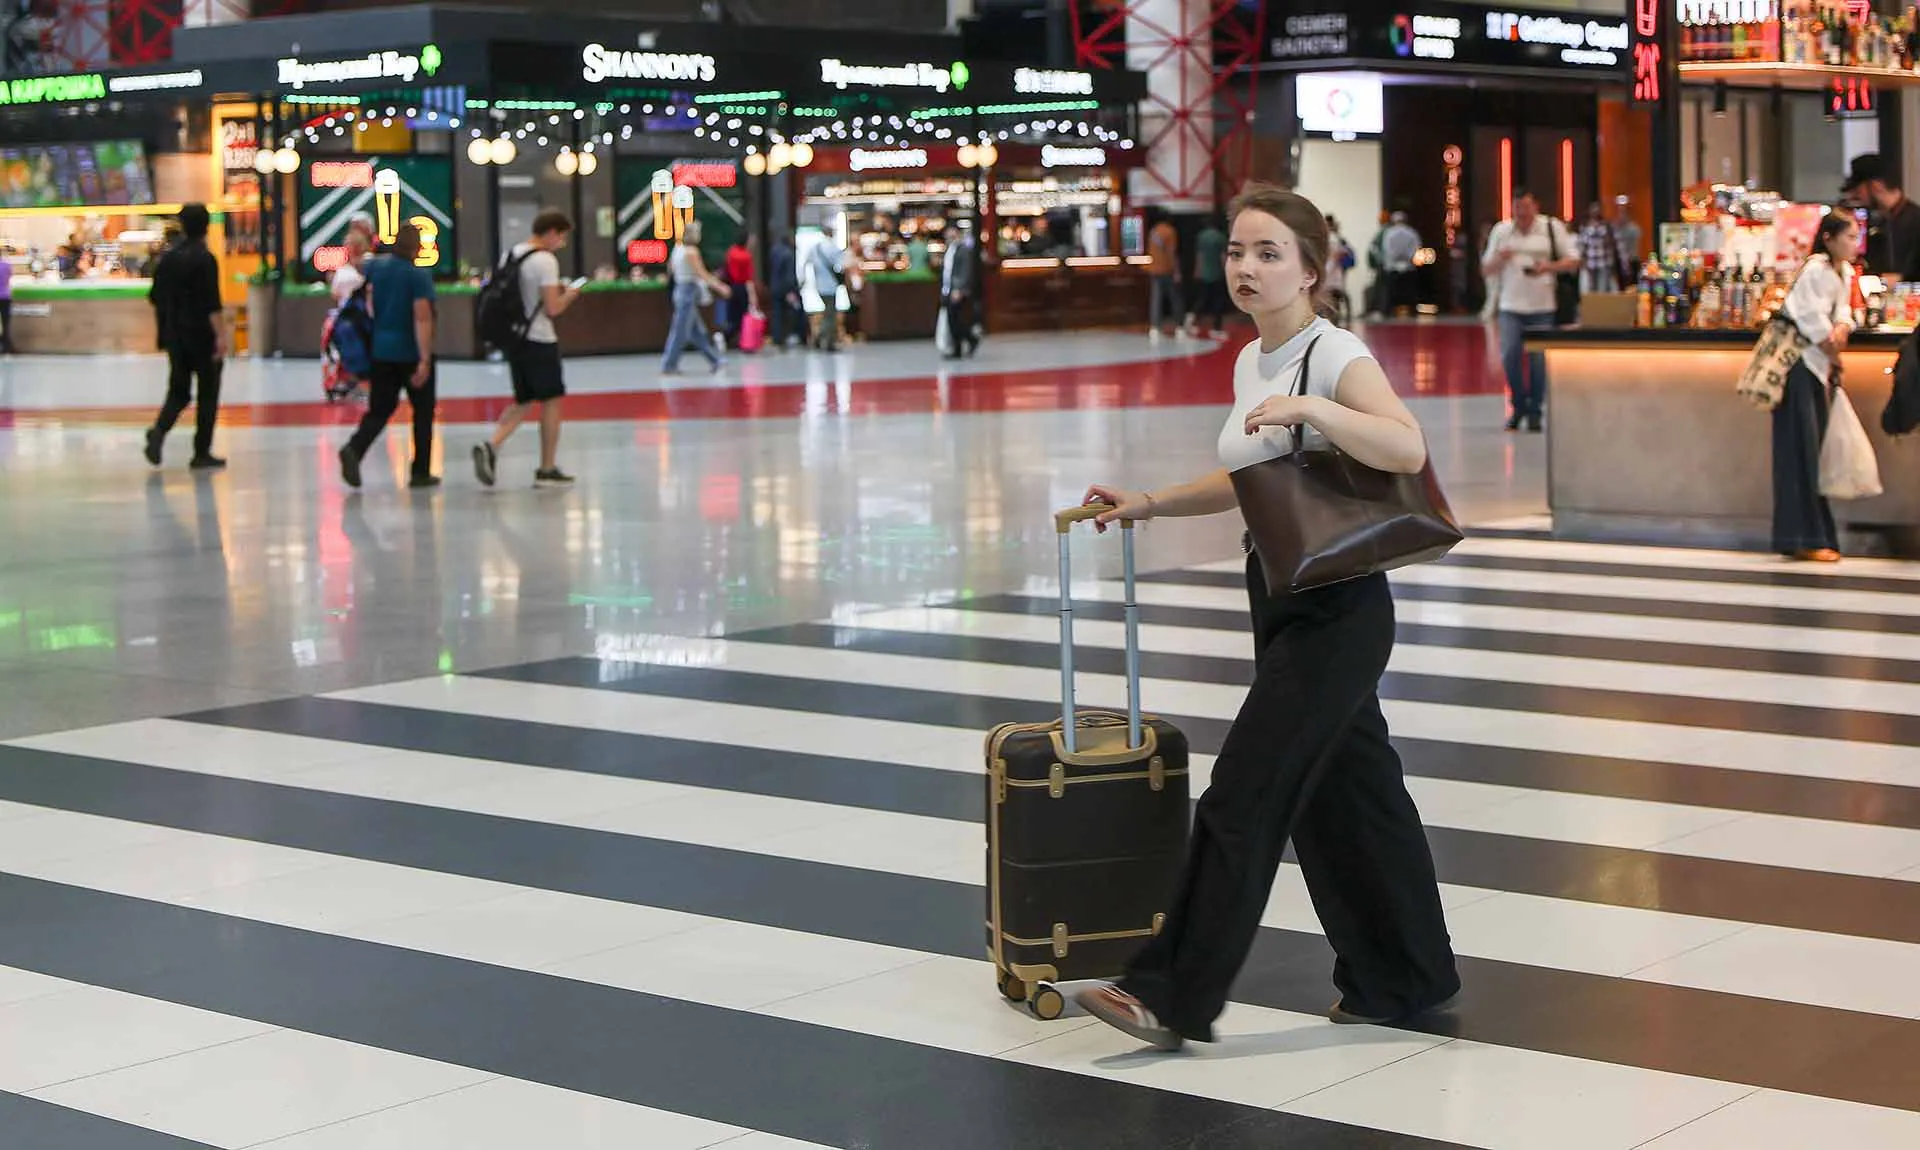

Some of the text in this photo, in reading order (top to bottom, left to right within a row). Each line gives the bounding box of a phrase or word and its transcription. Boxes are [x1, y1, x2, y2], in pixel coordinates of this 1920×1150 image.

[1286, 14, 1347, 35] ОБМЕН
[1271, 34, 1348, 56] ВАЛЮТЫ
[582, 43, 716, 82] SHANNON'S
